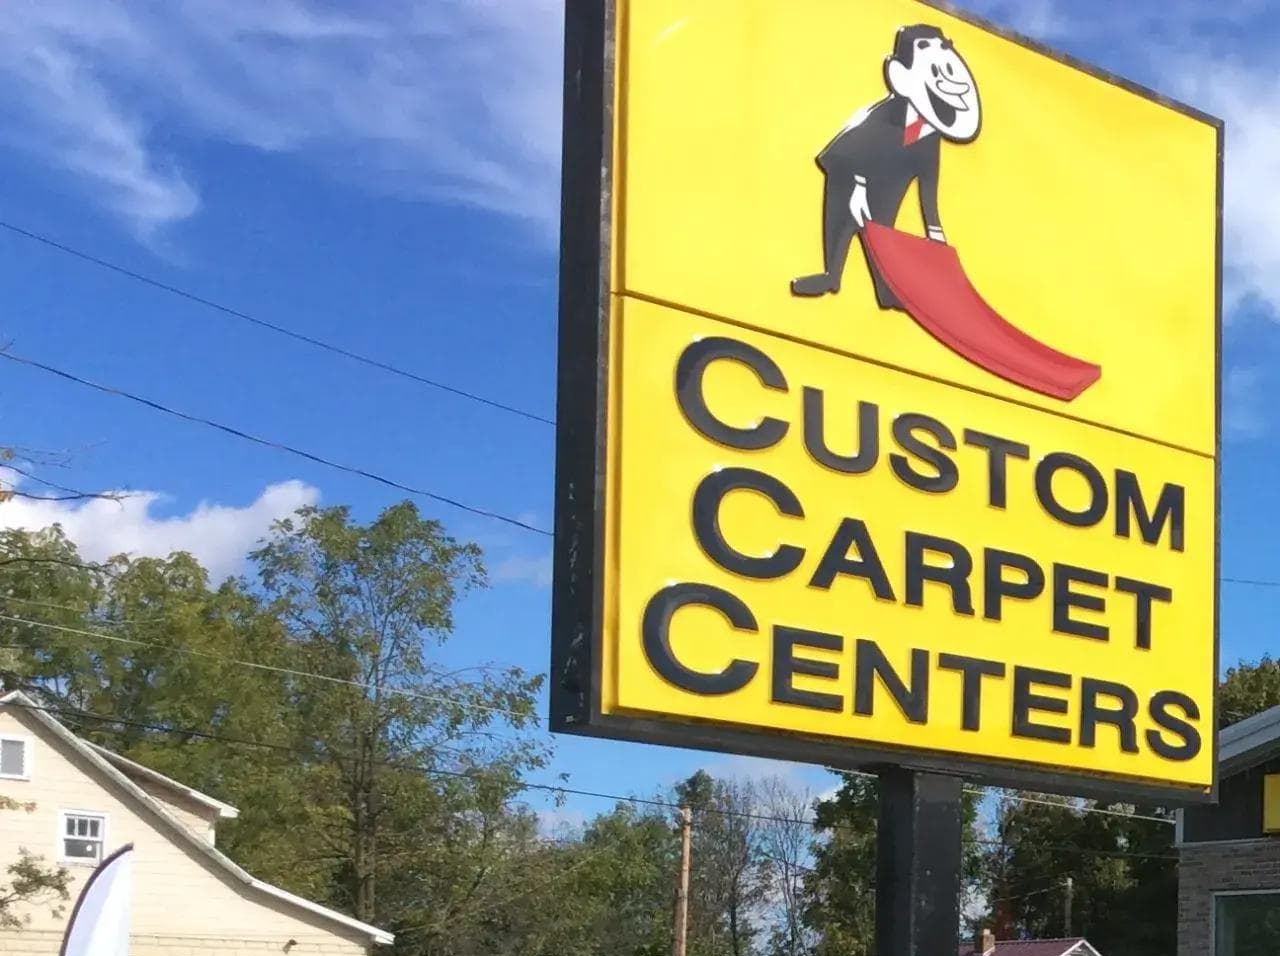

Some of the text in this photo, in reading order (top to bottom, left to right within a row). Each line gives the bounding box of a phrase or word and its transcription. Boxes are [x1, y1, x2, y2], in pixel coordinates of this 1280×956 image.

[674, 336, 1186, 554] CUSTOM
[690, 466, 1173, 650] CARPET
[641, 582, 1201, 761] CENTERS
